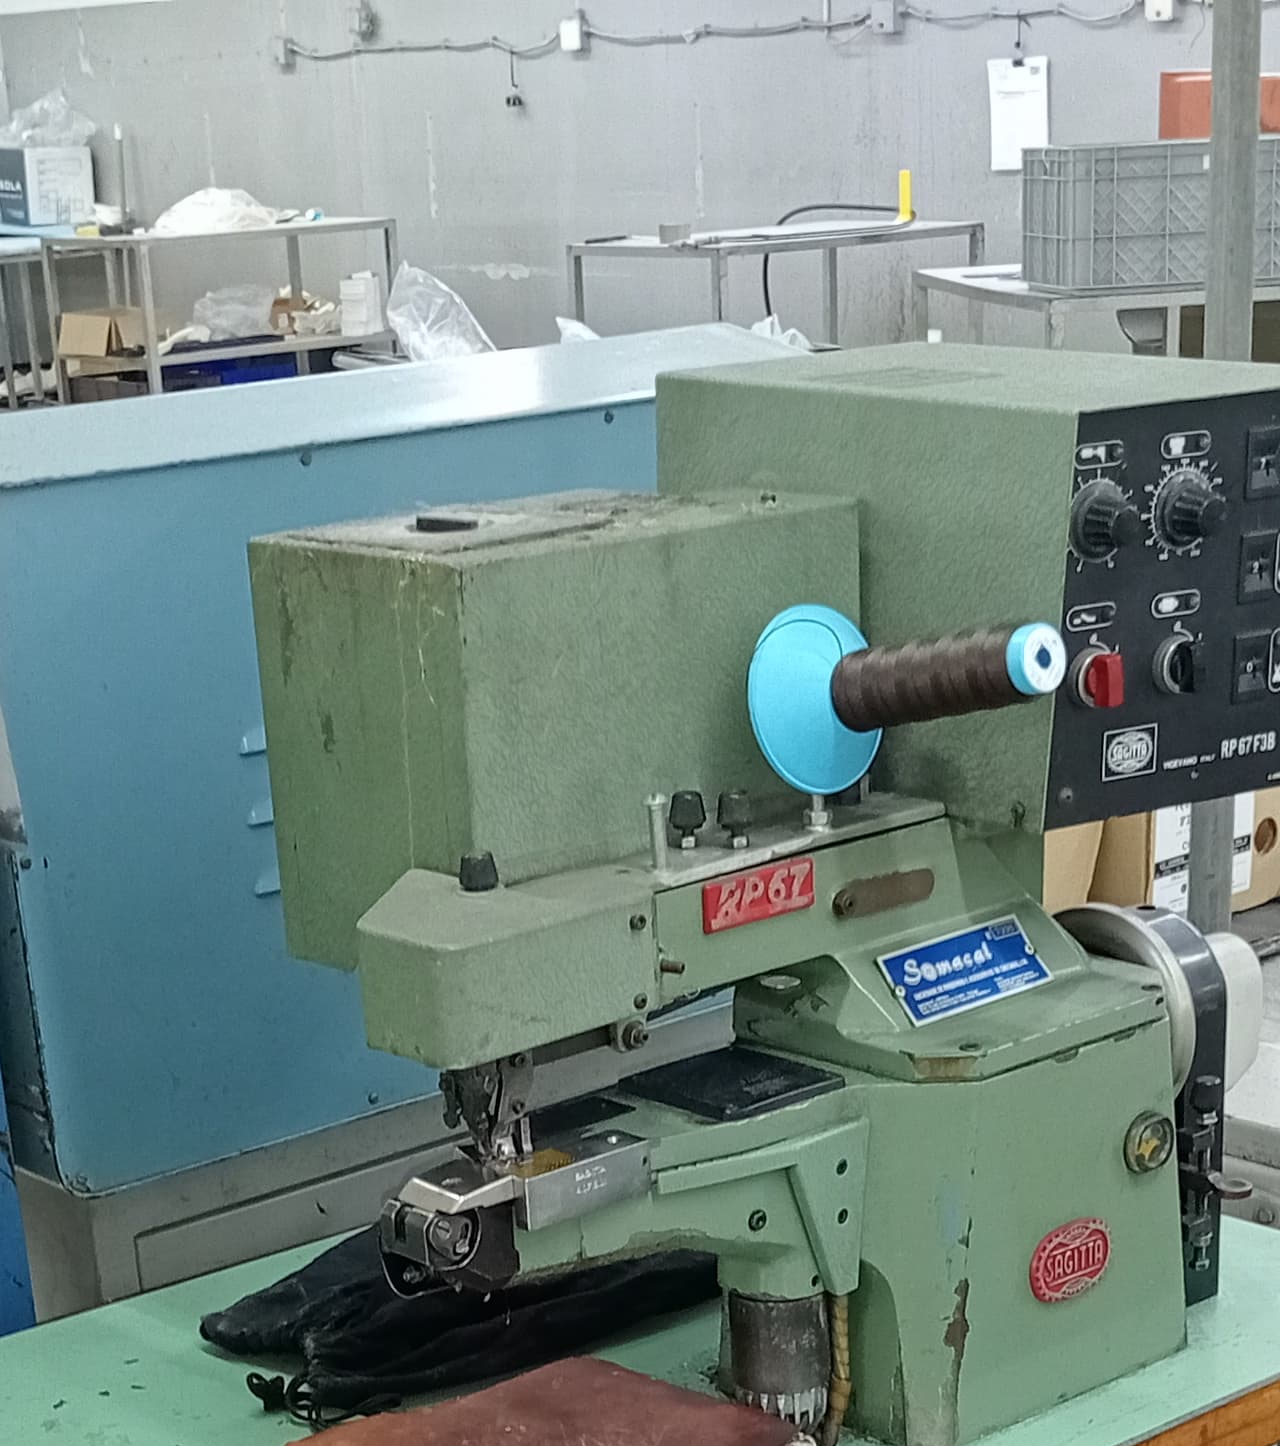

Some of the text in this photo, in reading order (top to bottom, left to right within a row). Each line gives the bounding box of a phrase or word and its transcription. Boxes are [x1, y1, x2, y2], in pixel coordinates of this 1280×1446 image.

[1111, 741, 1148, 763] SAGITTA
[903, 940, 993, 986] Somacal
[1046, 1239, 1104, 1283] SAGITTA
